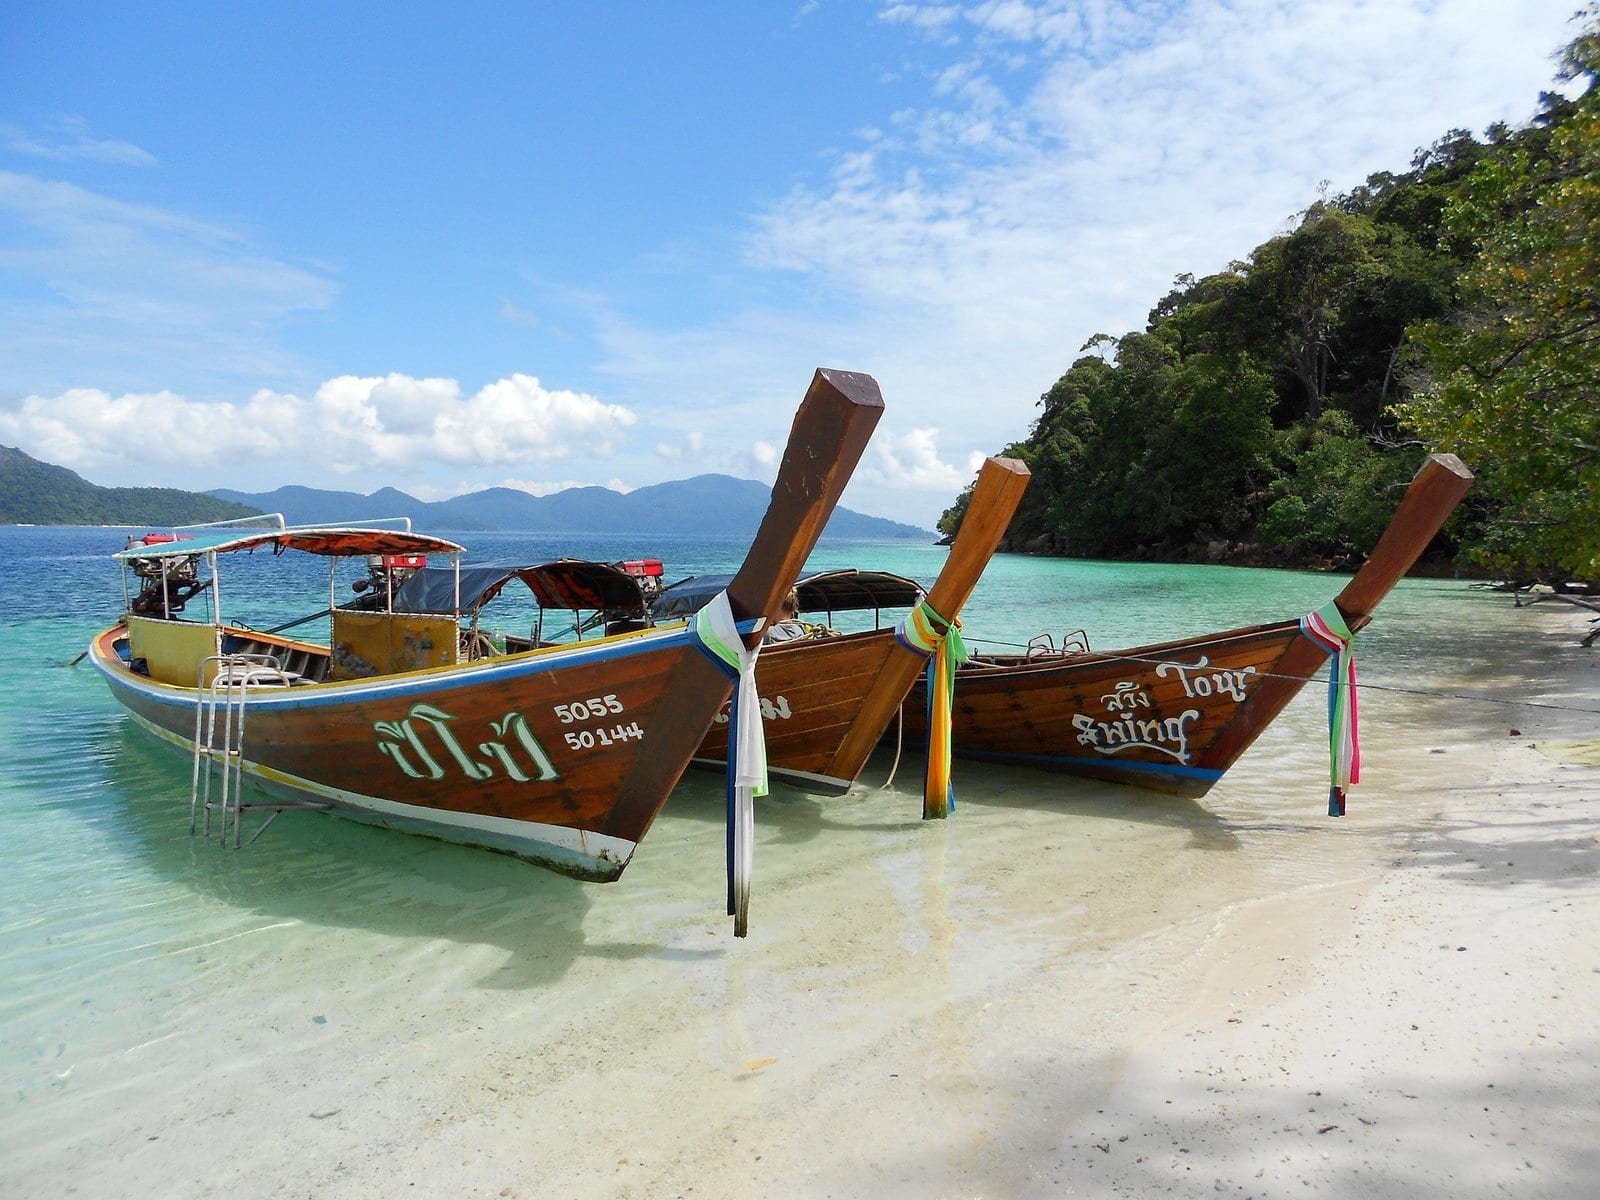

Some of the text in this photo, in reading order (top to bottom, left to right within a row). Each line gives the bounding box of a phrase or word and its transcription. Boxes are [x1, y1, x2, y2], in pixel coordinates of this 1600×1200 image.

[1156, 656, 1256, 702] Tour
[554, 694, 624, 724] 5055
[1072, 709, 1199, 765] Swing
